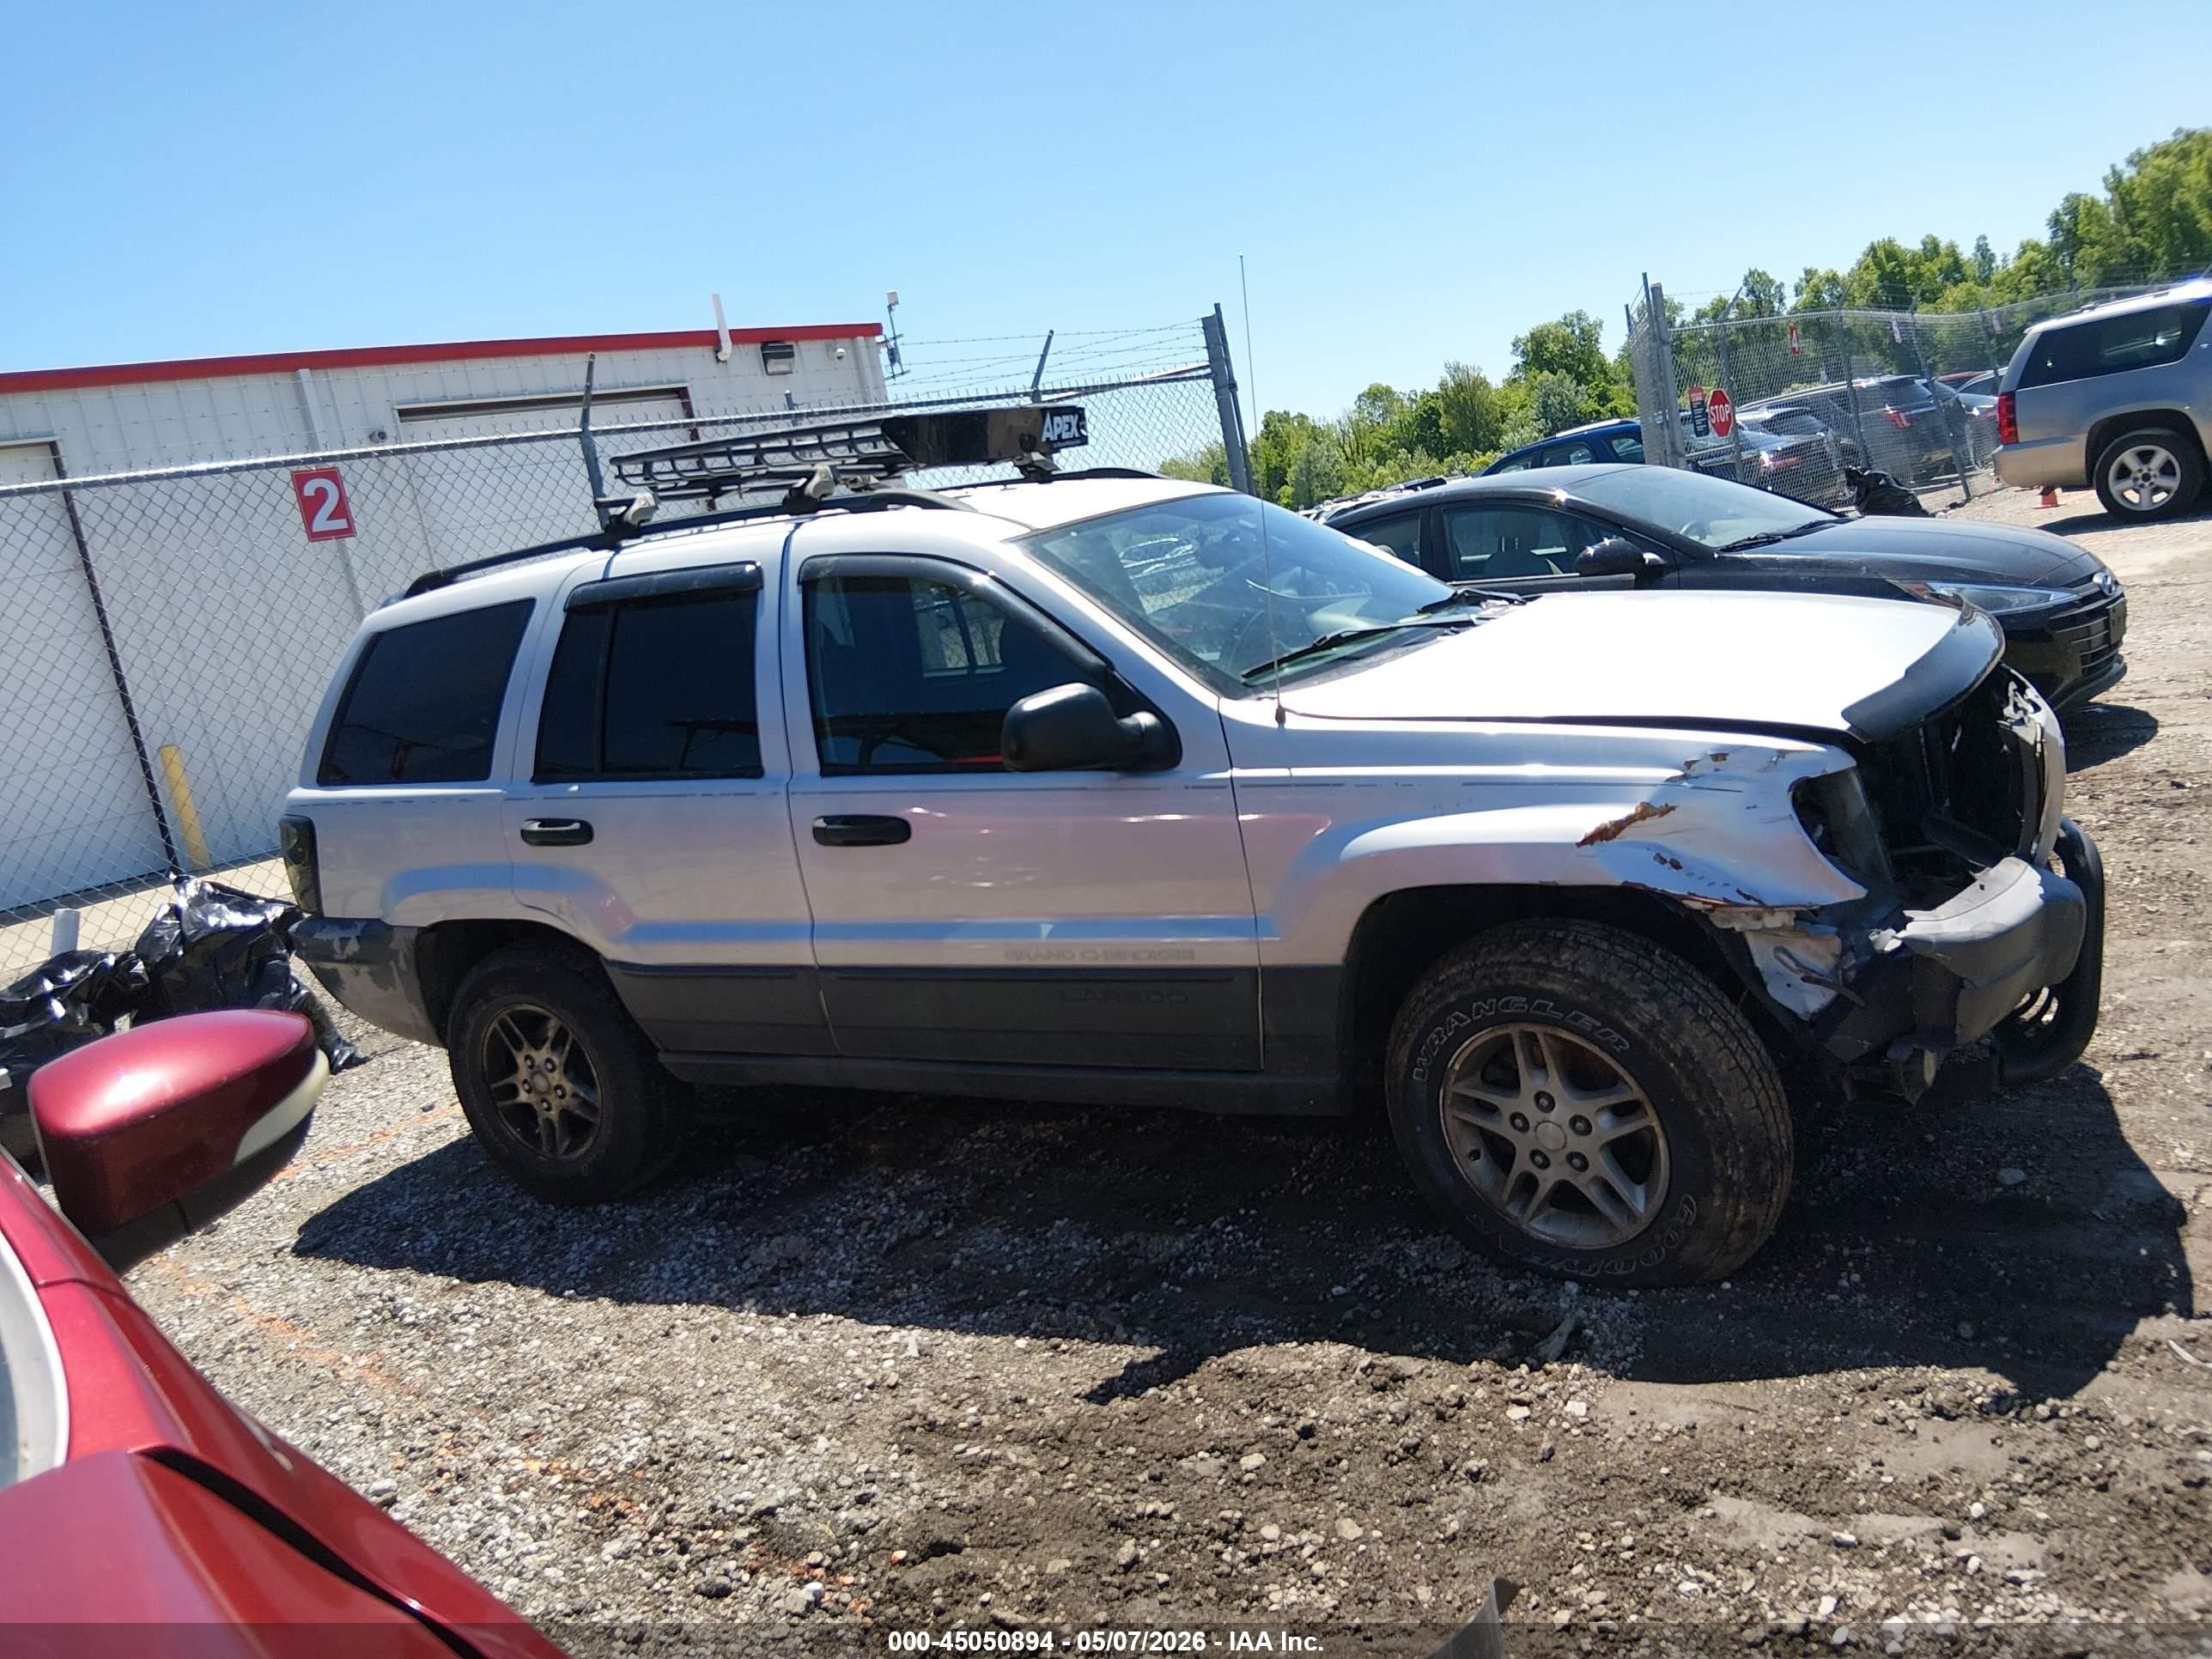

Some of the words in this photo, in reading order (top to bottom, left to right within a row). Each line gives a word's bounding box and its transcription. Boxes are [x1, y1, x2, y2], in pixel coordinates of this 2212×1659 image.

[1041, 411, 1079, 441] APEX
[1710, 404, 1730, 424] STOP
[303, 477, 349, 532] 2
[1004, 947, 1076, 962] GRAND
[1412, 994, 1632, 1084] WRANGLER
